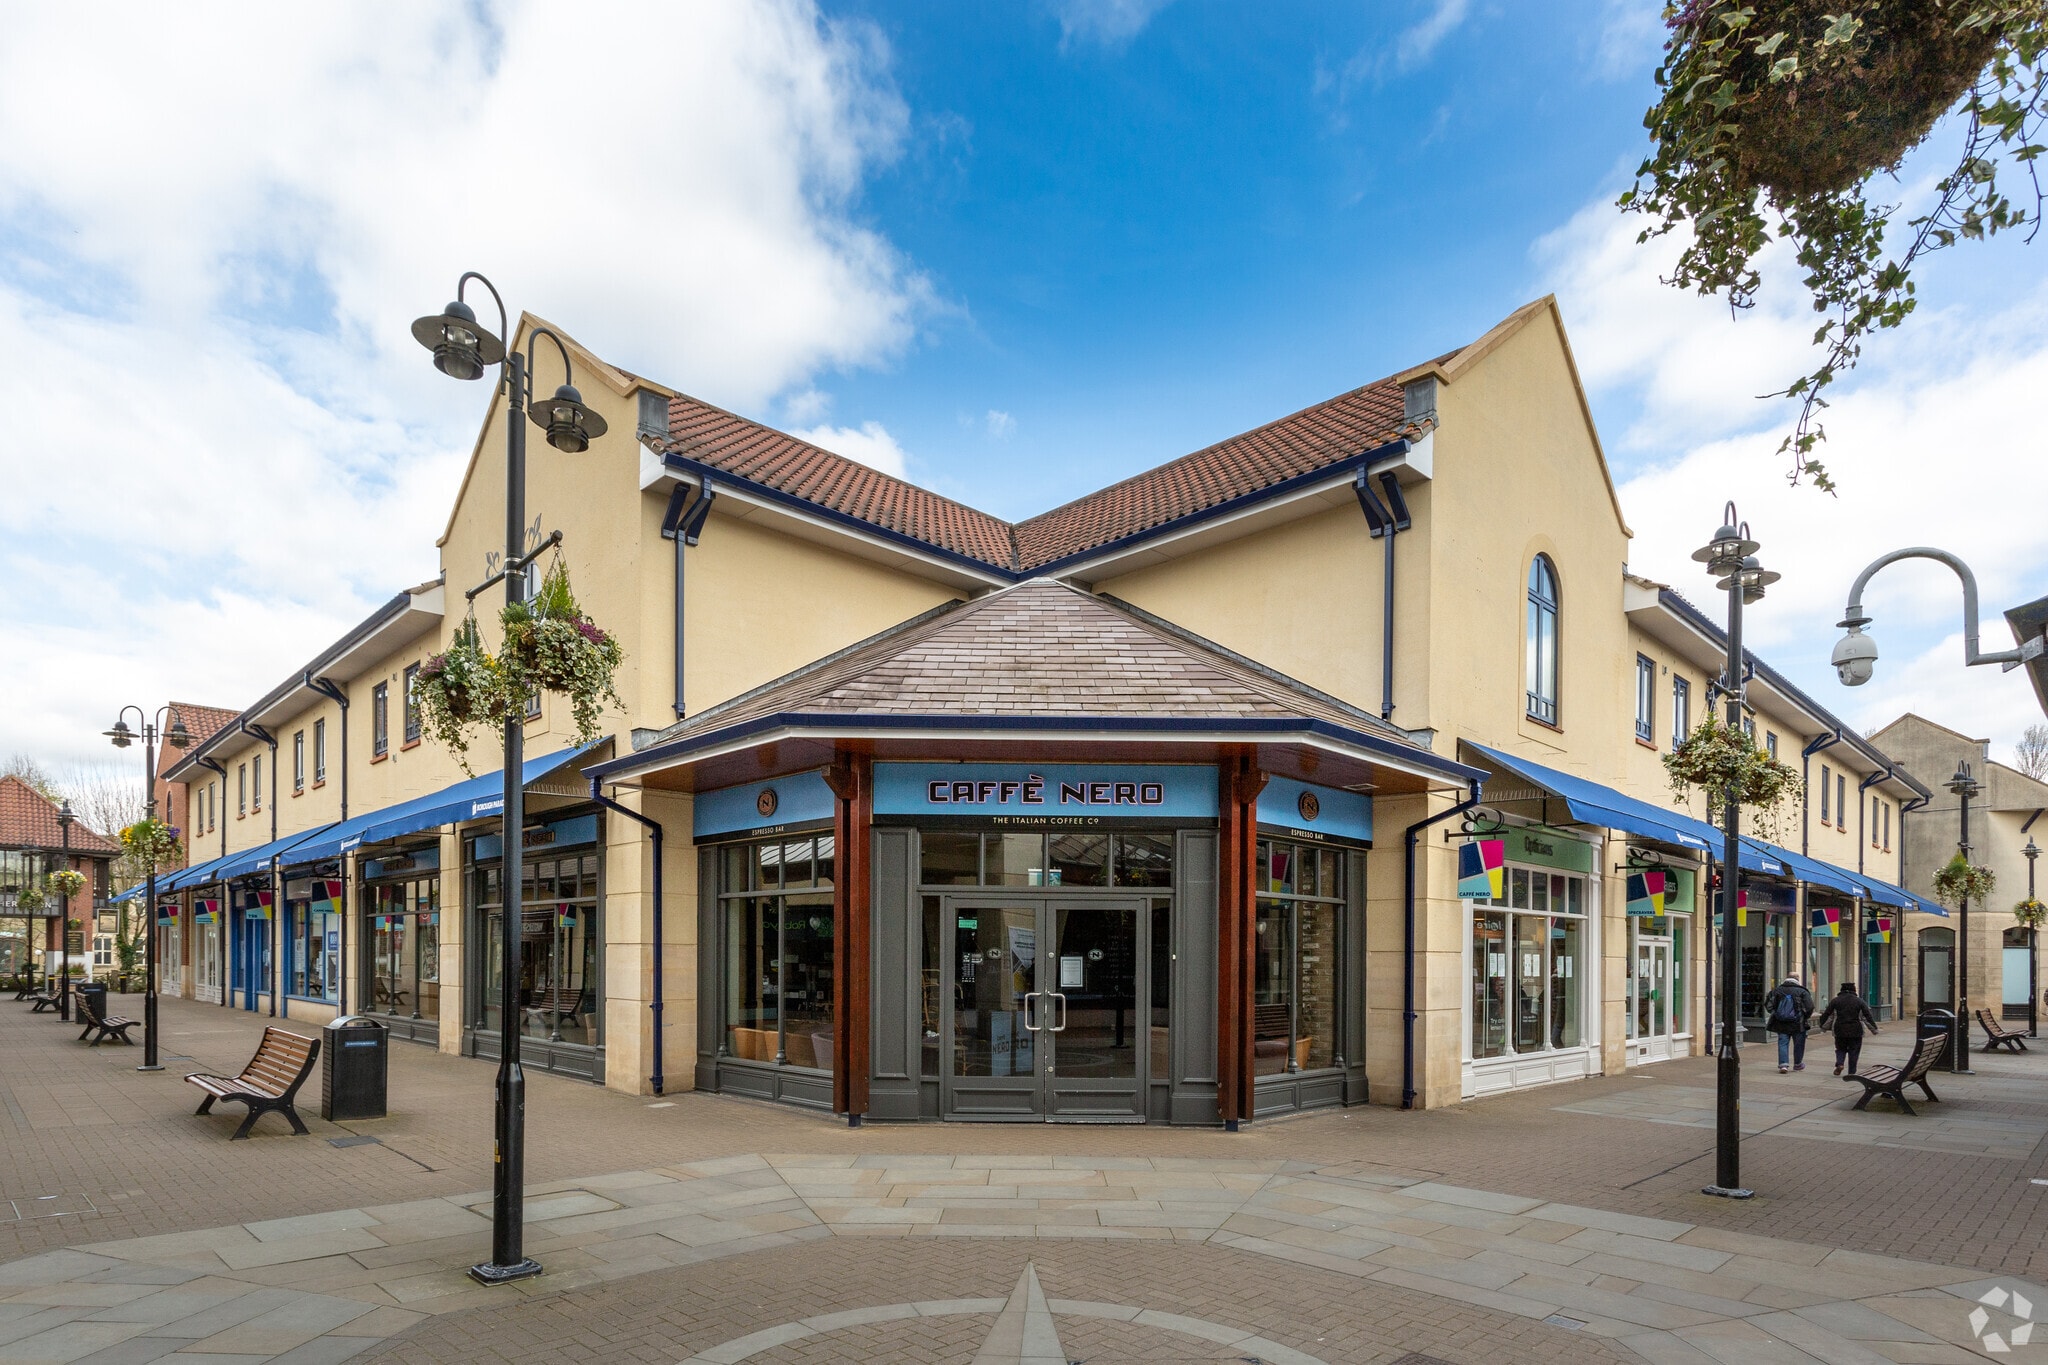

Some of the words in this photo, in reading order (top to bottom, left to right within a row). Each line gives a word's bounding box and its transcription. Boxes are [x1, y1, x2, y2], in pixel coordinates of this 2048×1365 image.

[928, 773, 1044, 804] CAFFÈ
[1060, 781, 1164, 805] NERO
[1012, 817, 1047, 825] ITALIAN
[1050, 817, 1084, 825] COFFEE
[752, 828, 774, 836] ESPRESSO
[775, 825, 784, 833] BAR
[1291, 829, 1314, 839] ESPRESSO
